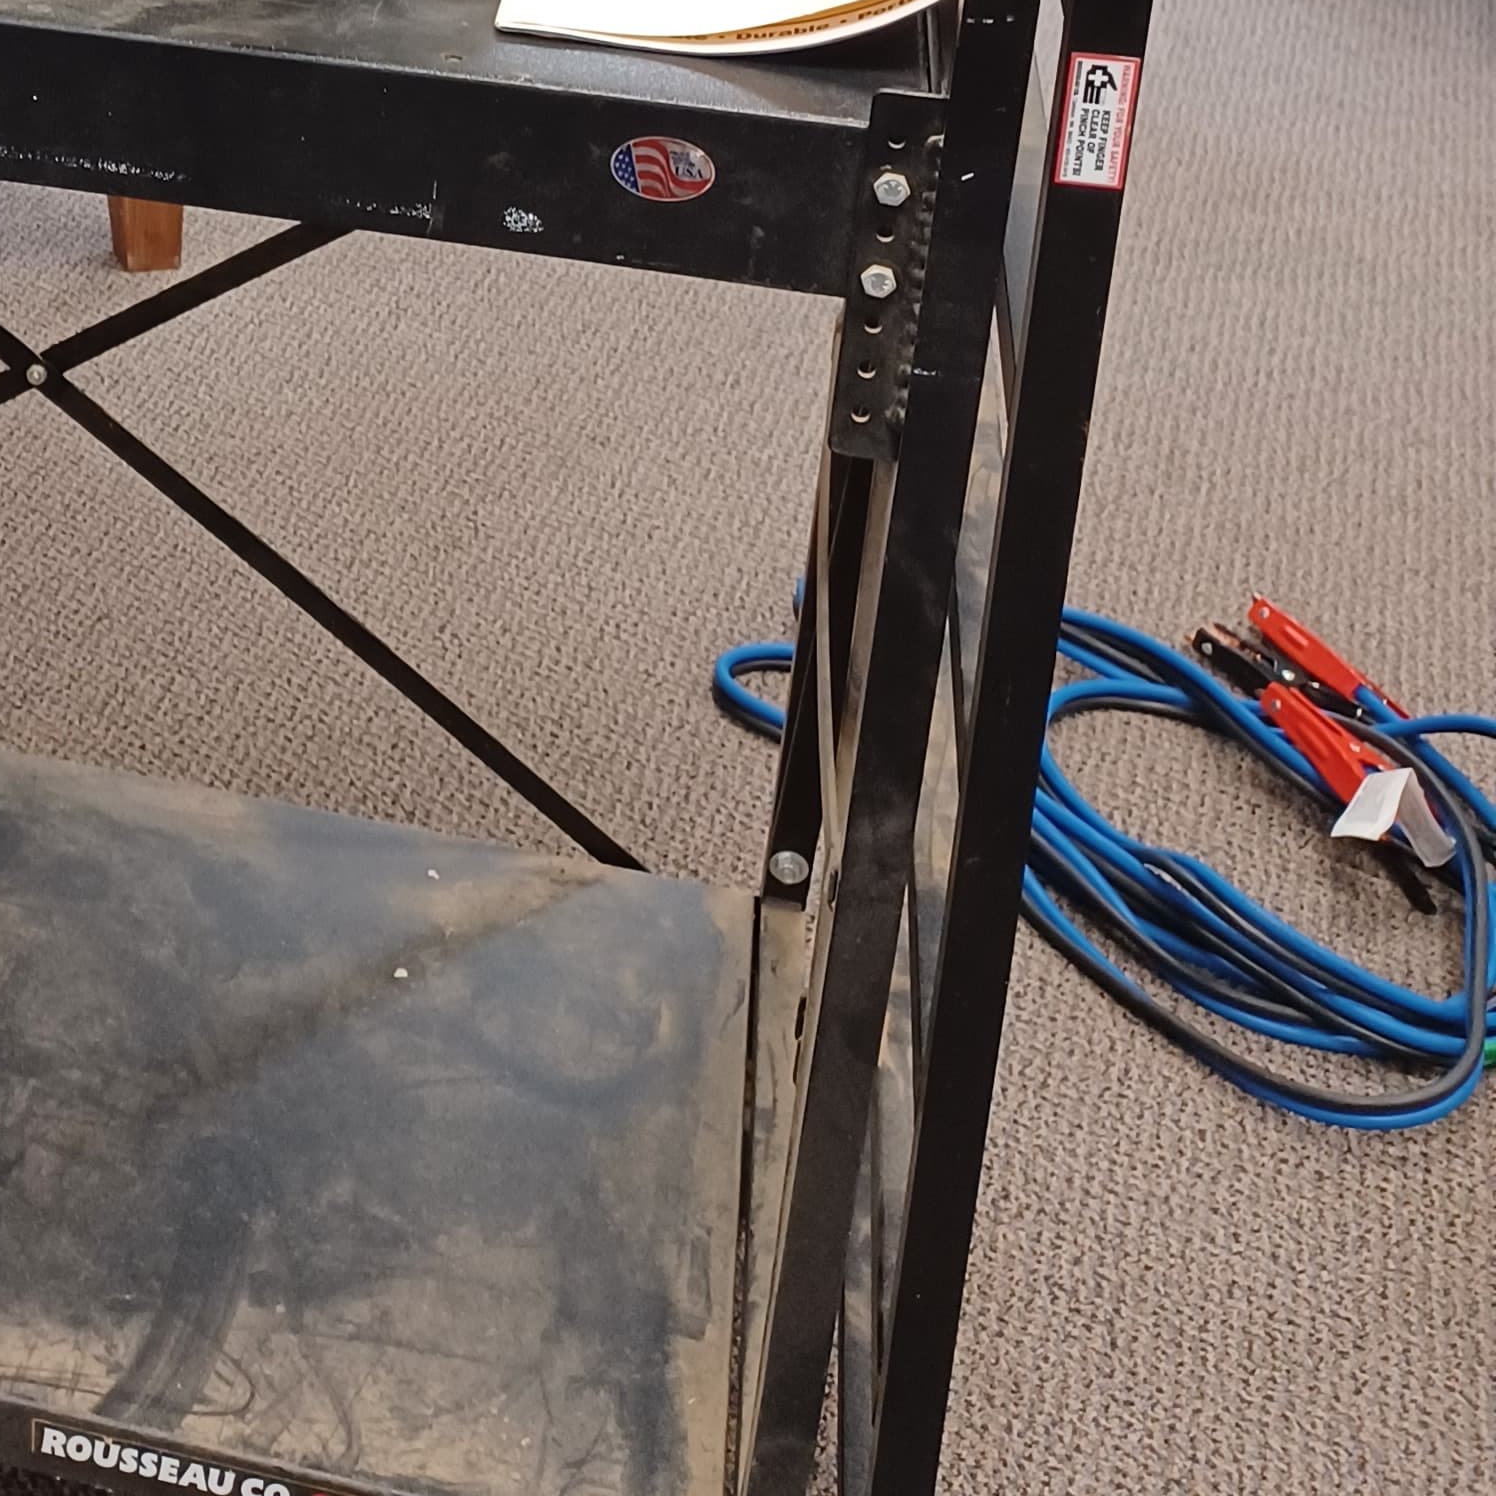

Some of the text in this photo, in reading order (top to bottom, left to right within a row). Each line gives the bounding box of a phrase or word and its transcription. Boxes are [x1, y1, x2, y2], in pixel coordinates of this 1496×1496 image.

[736, 23, 830, 41] Durable
[1078, 107, 1090, 137] PINCH
[1086, 109, 1101, 154] CLEAR OF
[1100, 110, 1111, 135] KEEP
[674, 165, 704, 180] USA
[40, 1426, 236, 1496] ROUSSEAU
